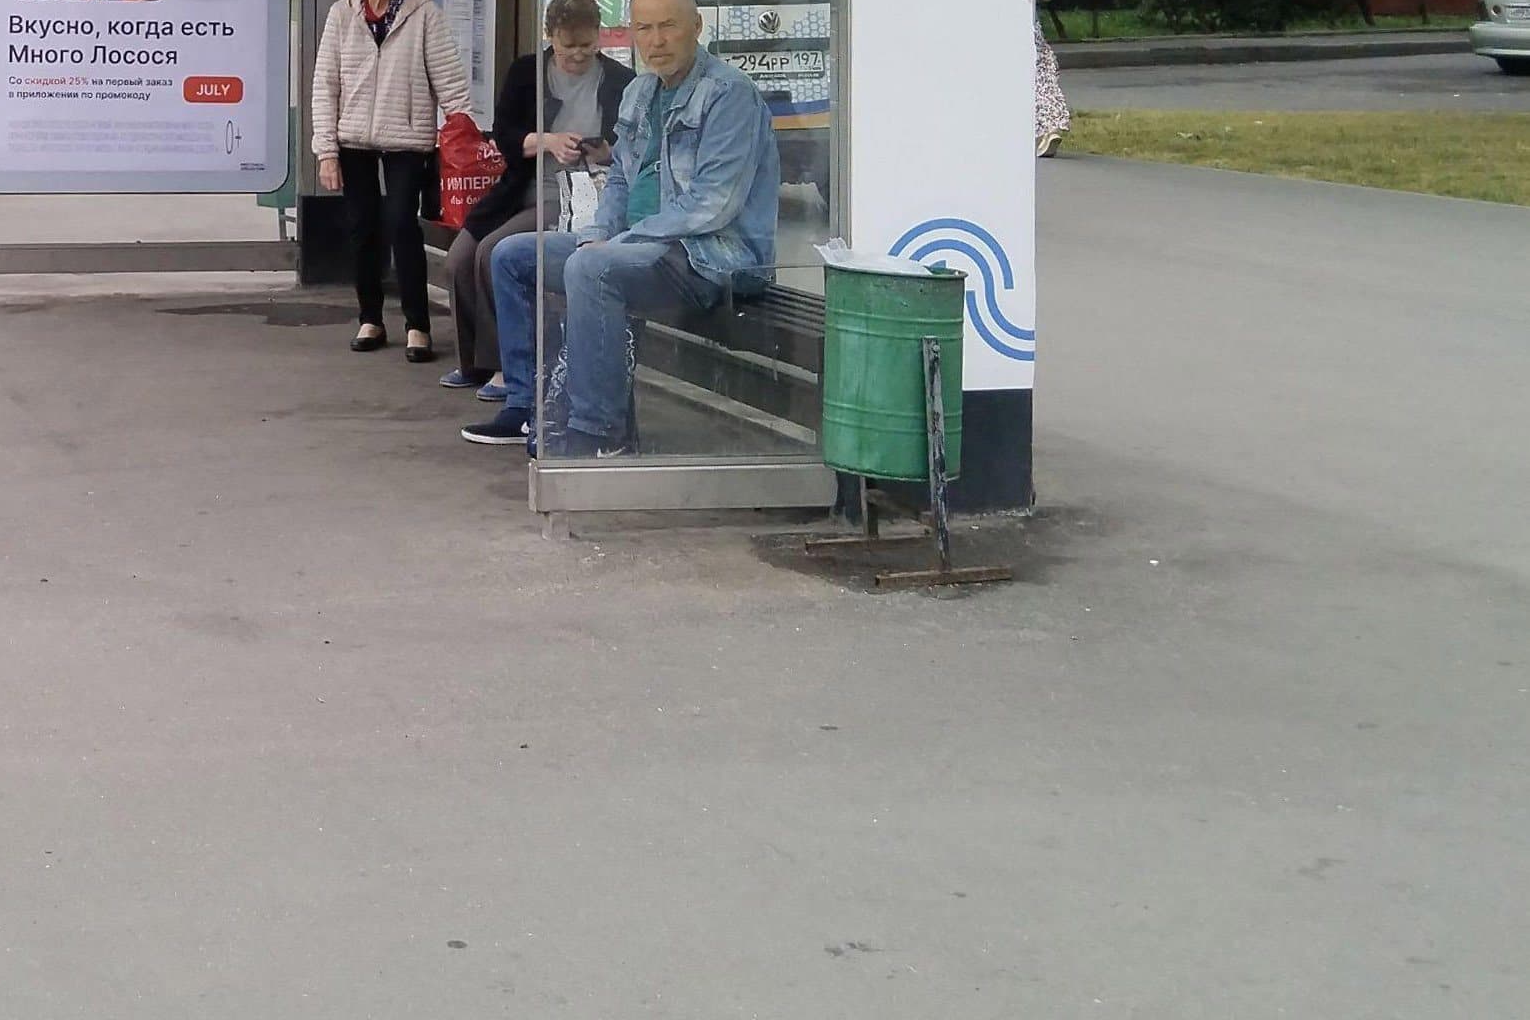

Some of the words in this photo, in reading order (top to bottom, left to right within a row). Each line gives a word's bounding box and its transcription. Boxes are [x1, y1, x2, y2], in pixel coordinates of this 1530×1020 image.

[8, 15, 102, 40] Вкусно,
[107, 21, 174, 40] когда
[181, 22, 235, 37] есть
[8, 45, 84, 64] Много
[90, 46, 179, 65] Лосося
[794, 52, 819, 66] 197
[8, 76, 23, 86] Со
[24, 76, 67, 87] скидкой
[69, 77, 89, 86] 25%
[105, 77, 144, 88] первый
[16, 91, 79, 101] приложении
[95, 92, 152, 102] промокоду
[196, 83, 231, 97] JULY
